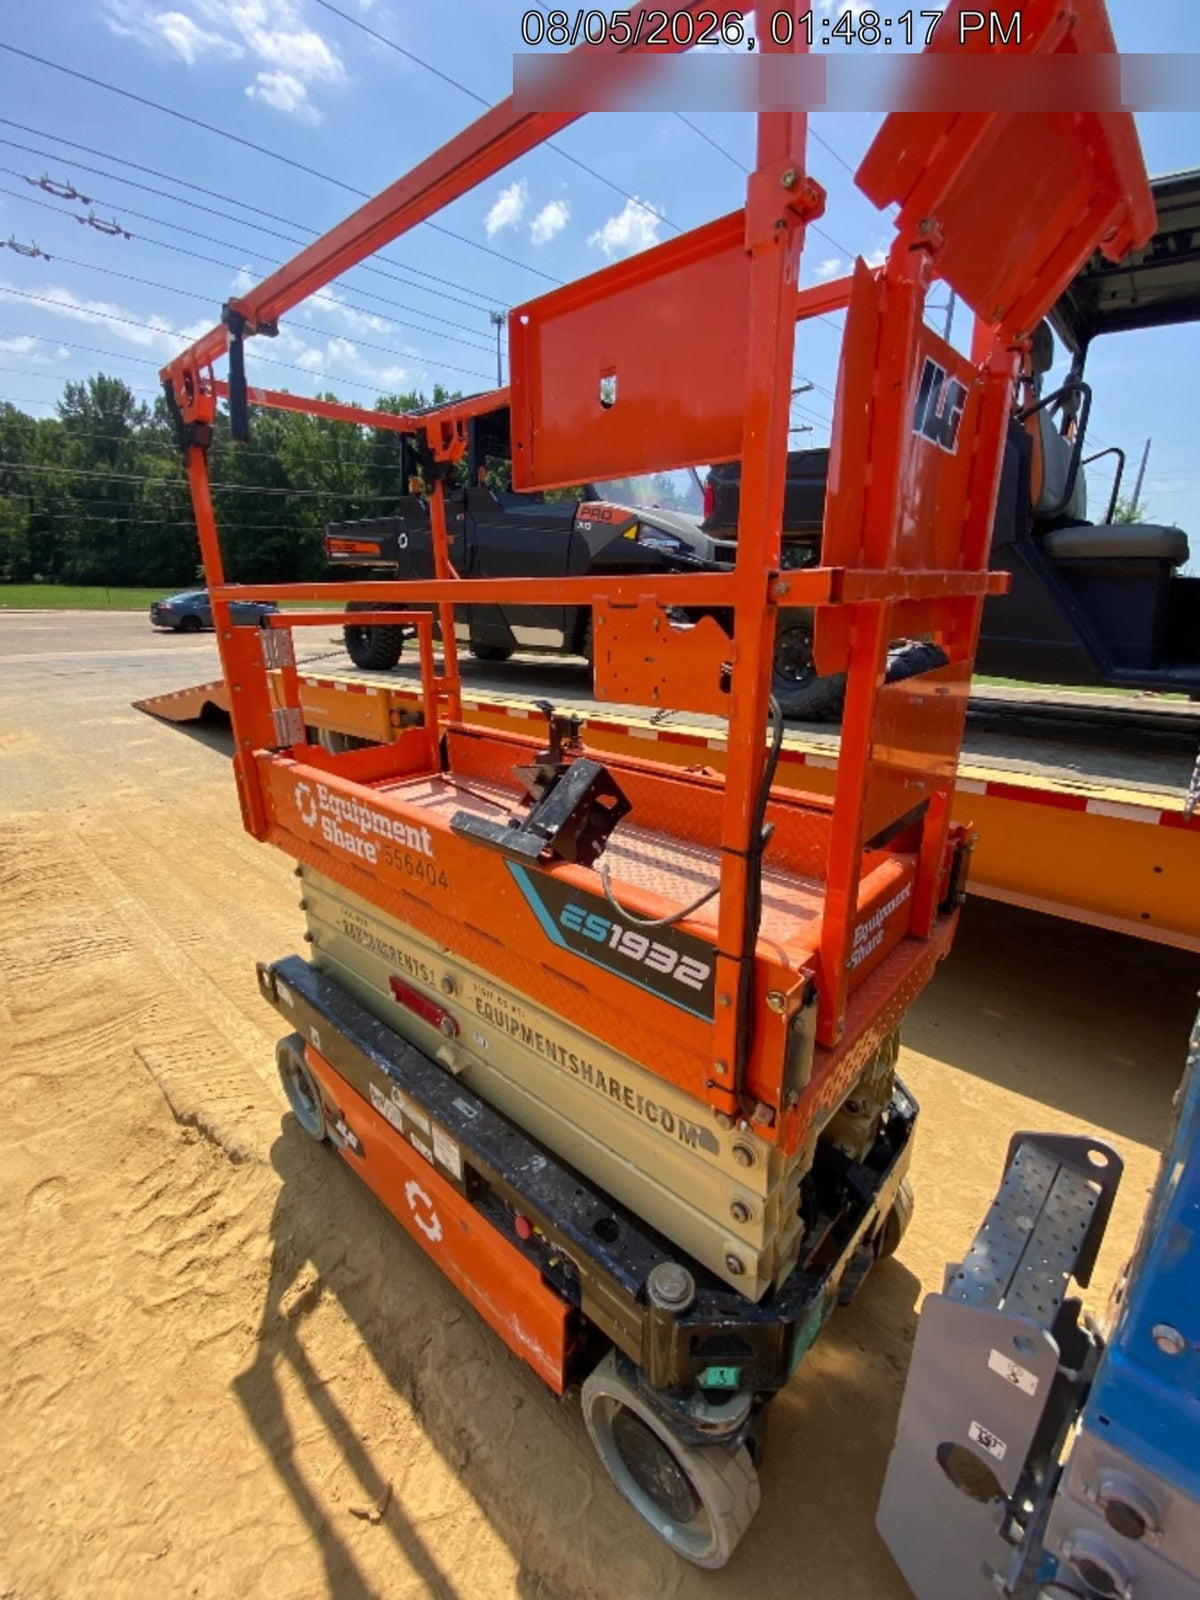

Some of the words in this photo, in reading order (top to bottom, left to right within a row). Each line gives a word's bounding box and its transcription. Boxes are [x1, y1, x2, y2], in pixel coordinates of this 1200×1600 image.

[581, 506, 613, 521] PRO
[316, 783, 434, 860] Equipment
[321, 815, 378, 865] Share
[384, 845, 449, 891] 556404
[852, 881, 913, 948] Equipment
[559, 903, 711, 991] ES1932
